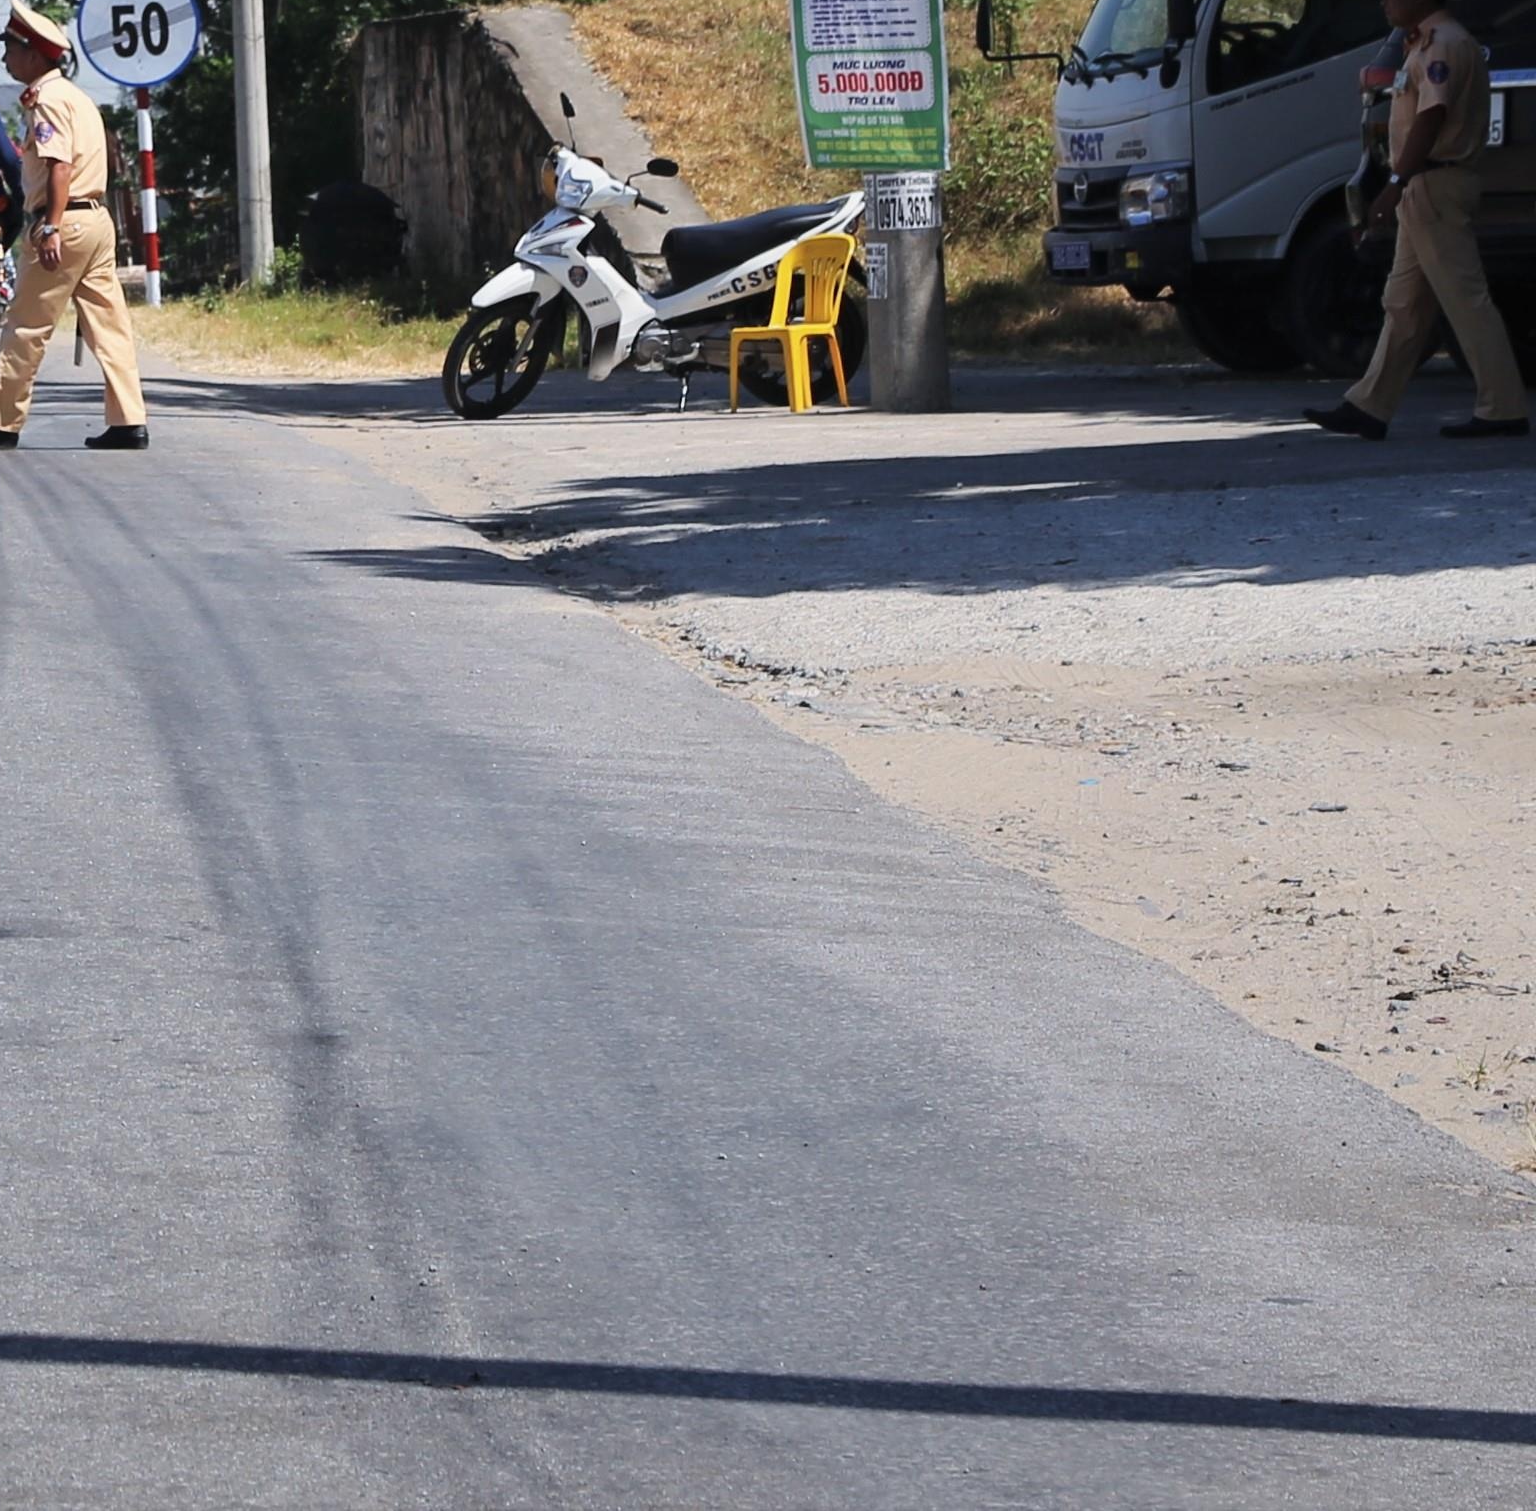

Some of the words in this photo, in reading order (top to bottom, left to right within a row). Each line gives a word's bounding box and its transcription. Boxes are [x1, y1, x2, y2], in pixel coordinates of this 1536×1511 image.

[111, 1, 170, 58] 50
[818, 71, 923, 94] 5.000.000Đ
[1070, 133, 1104, 161] CSGT
[879, 196, 934, 228] 0974.363.7
[731, 264, 778, 294] CSG
